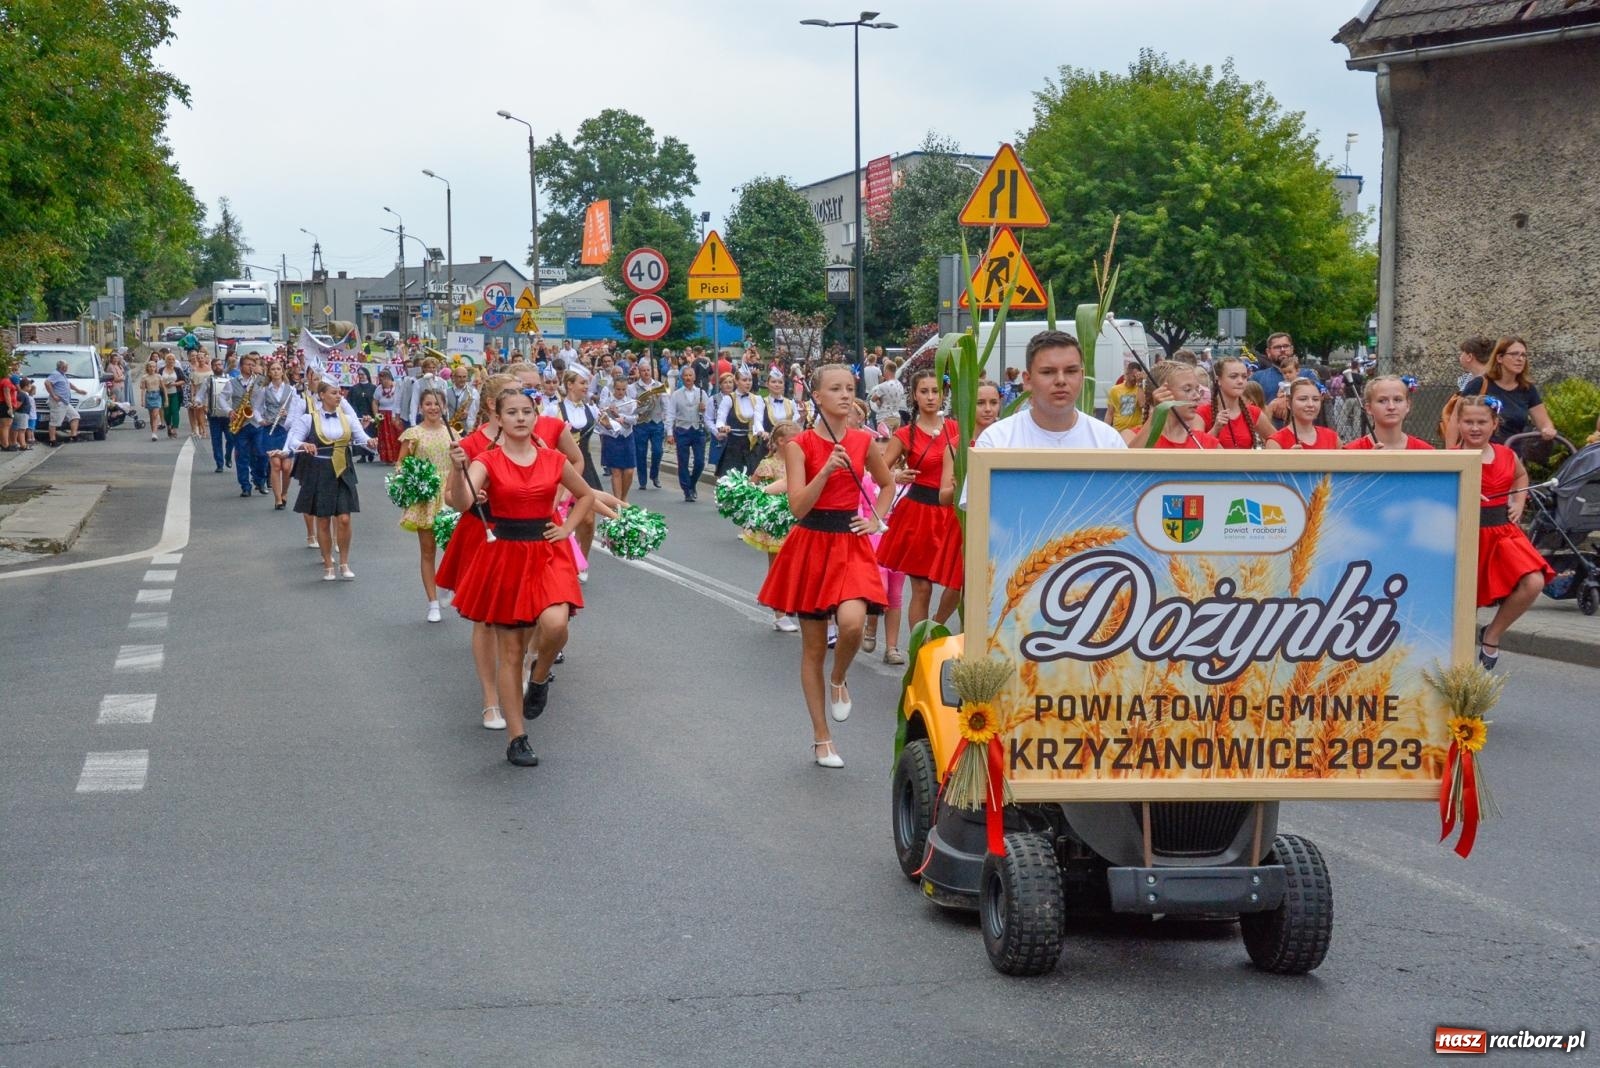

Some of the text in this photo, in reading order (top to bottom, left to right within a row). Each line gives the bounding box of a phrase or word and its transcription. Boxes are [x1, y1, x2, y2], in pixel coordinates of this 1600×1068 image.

[629, 260, 662, 282] 40
[700, 282, 729, 294] Piesi
[458, 336, 474, 344] DPS
[1224, 526, 1287, 535] powiat raciborski
[1025, 550, 1407, 684] Dożynki
[1035, 694, 1400, 722] POWIATOWO-GMINNE
[1010, 728, 1422, 771] KRZYŻANOWICE 2023
